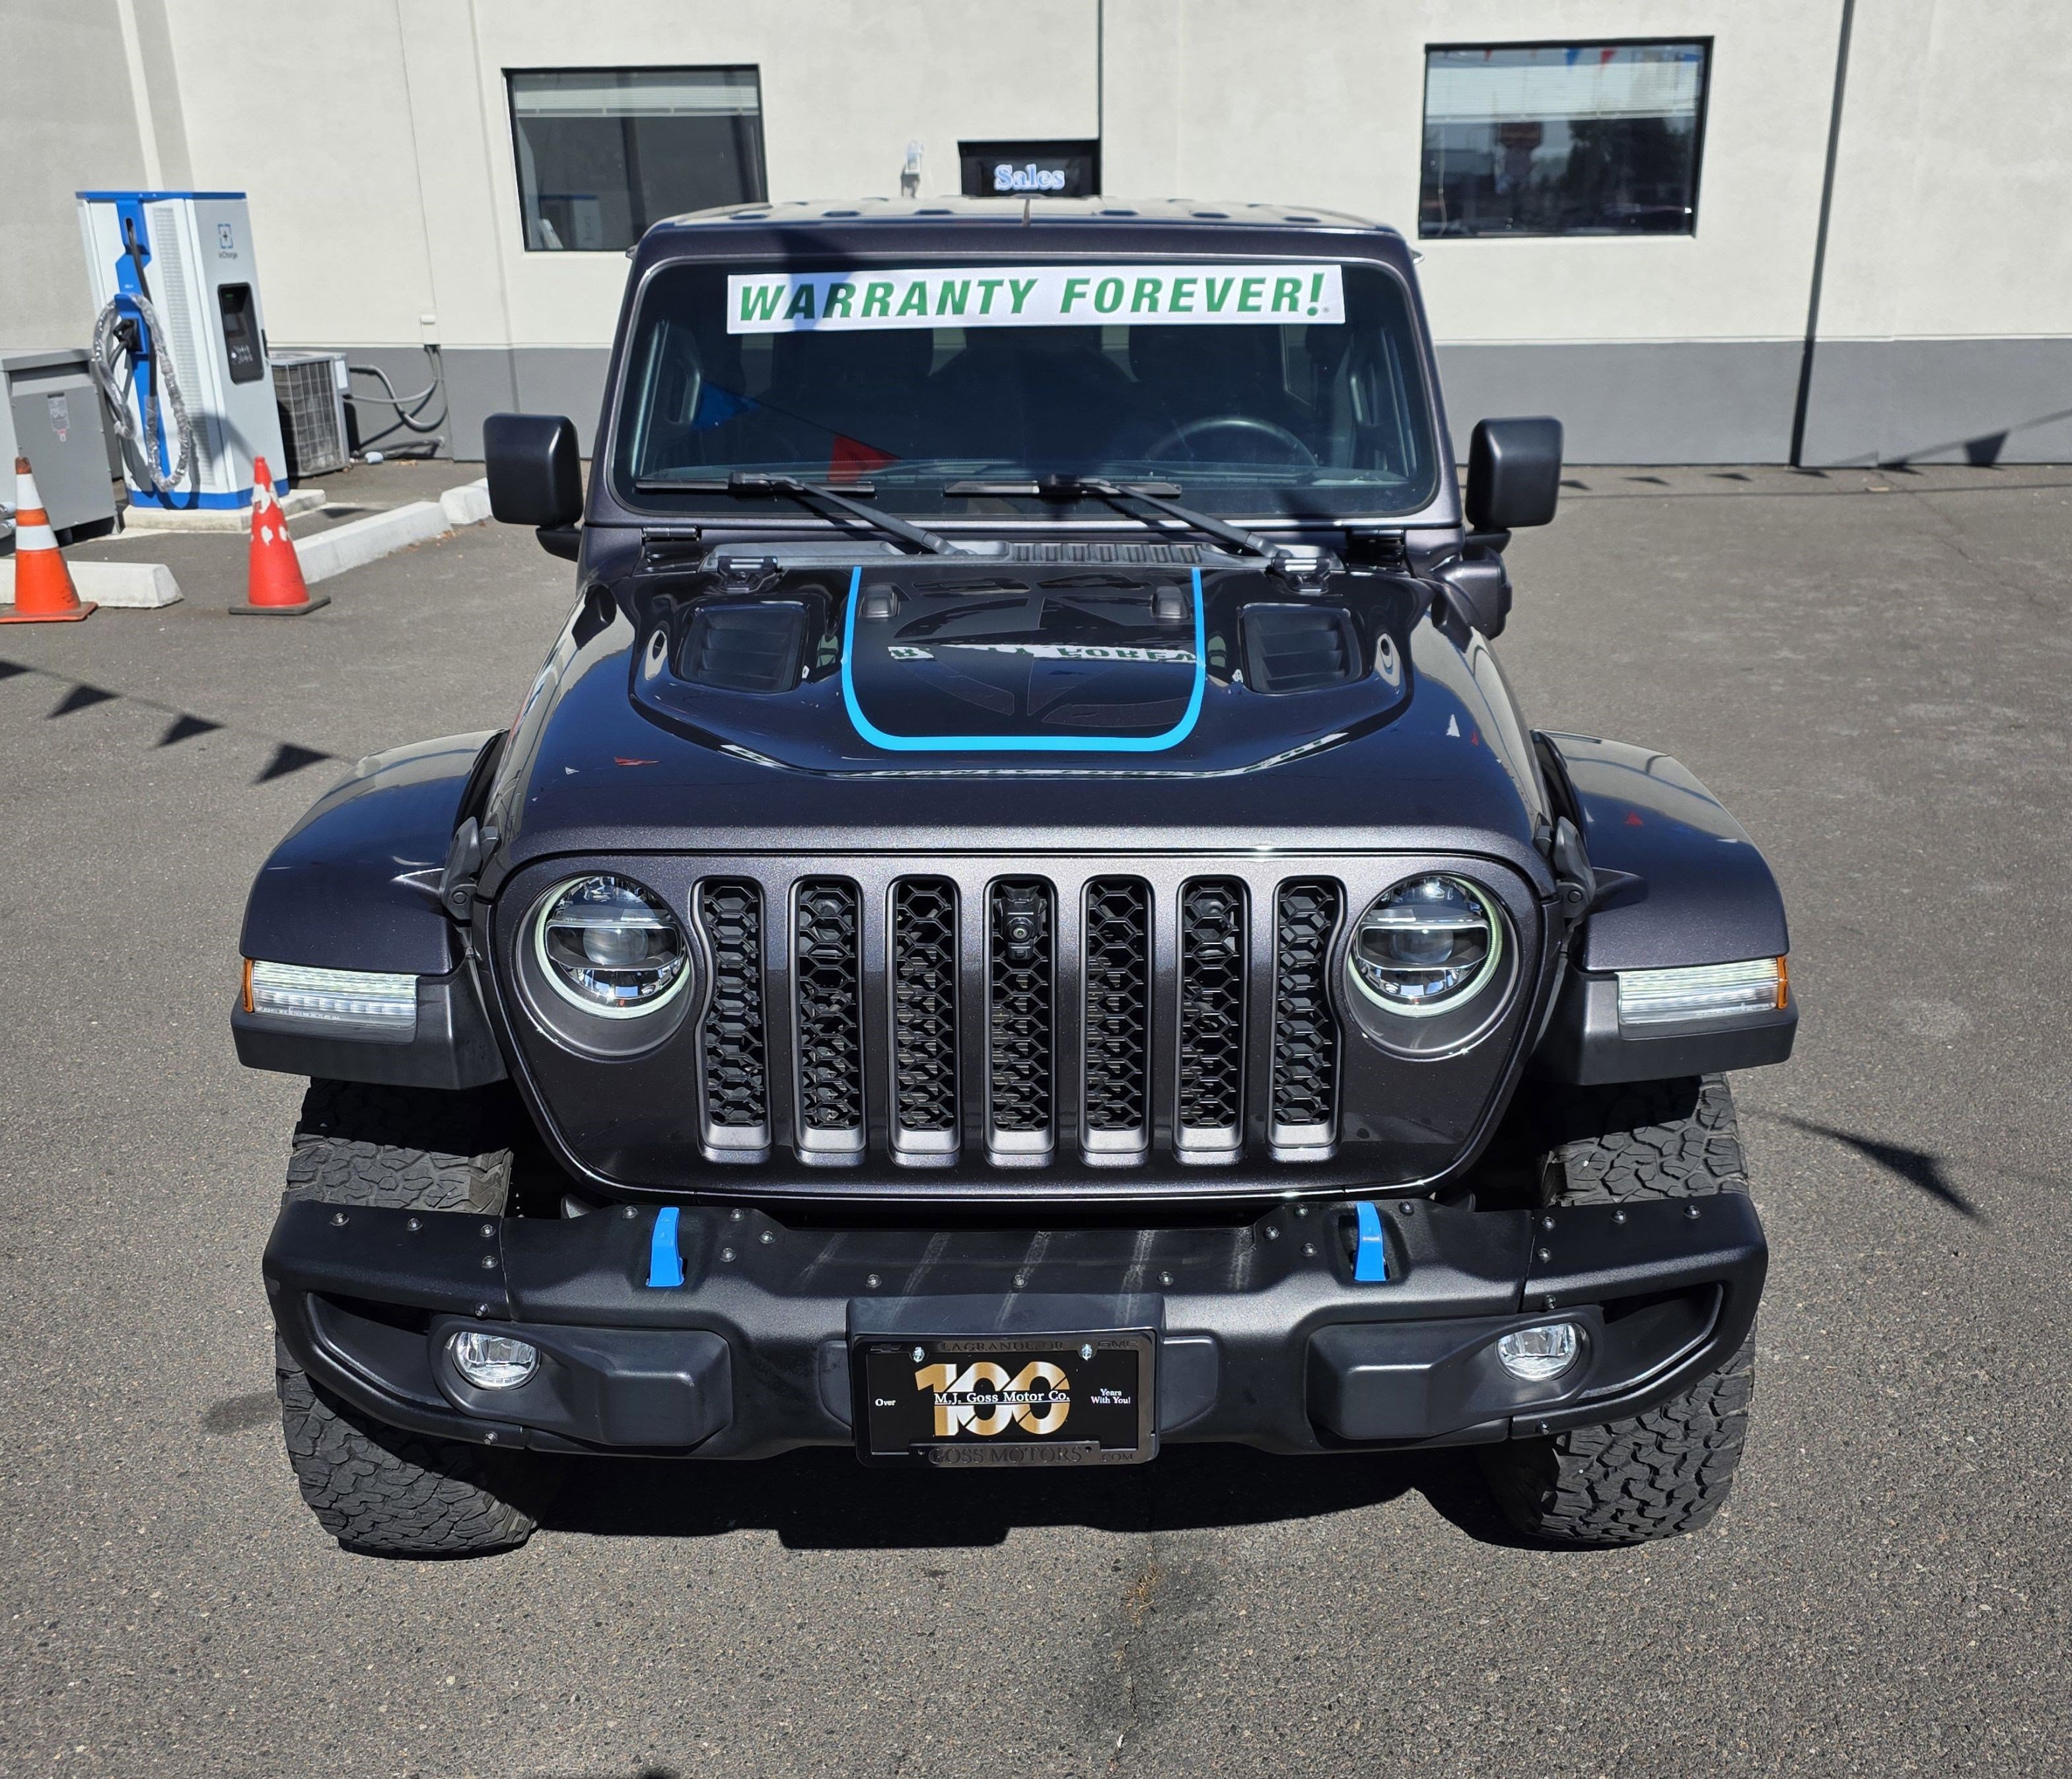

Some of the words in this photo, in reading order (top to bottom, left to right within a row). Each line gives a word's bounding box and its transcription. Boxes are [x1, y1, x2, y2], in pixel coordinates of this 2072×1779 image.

[993, 163, 1065, 191] Sales
[740, 277, 1039, 321] WARRANTY
[1059, 272, 1325, 316] FOREVER!
[1043, 1341, 1063, 1351] OR
[1097, 1339, 1139, 1349] GMC
[933, 1393, 962, 1405] M.J.
[966, 1392, 999, 1403] Goss
[1003, 1391, 1045, 1402] Motor
[1048, 1390, 1071, 1402] Co.
[1100, 1388, 1122, 1397] Years
[875, 1398, 896, 1406] Over
[915, 1361, 1071, 1437] 100
[1090, 1396, 1111, 1404] With
[1112, 1396, 1131, 1404] You!
[928, 1447, 984, 1465] GOSS
[991, 1446, 1082, 1463] MOTORS
